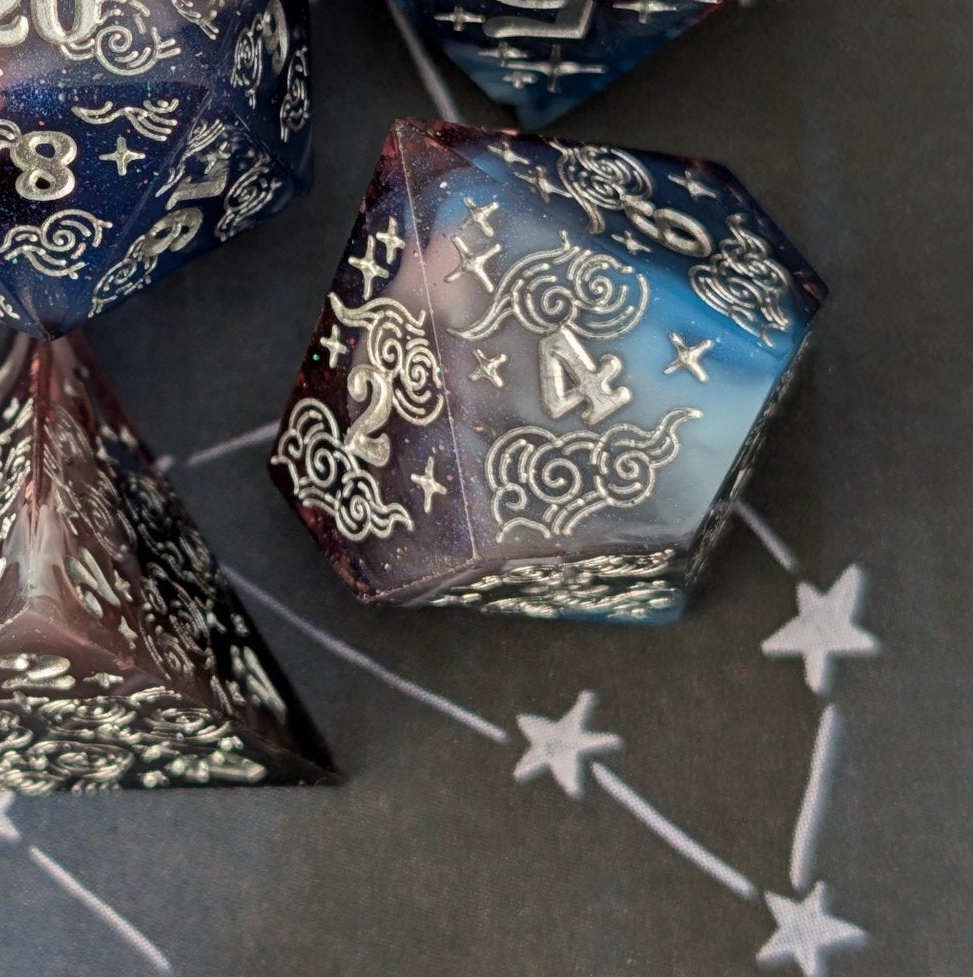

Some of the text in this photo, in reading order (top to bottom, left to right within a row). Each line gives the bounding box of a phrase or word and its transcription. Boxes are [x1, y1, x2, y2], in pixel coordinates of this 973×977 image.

[10, 131, 77, 202] 8
[347, 365, 393, 468] 2
[538, 326, 632, 426] 4
